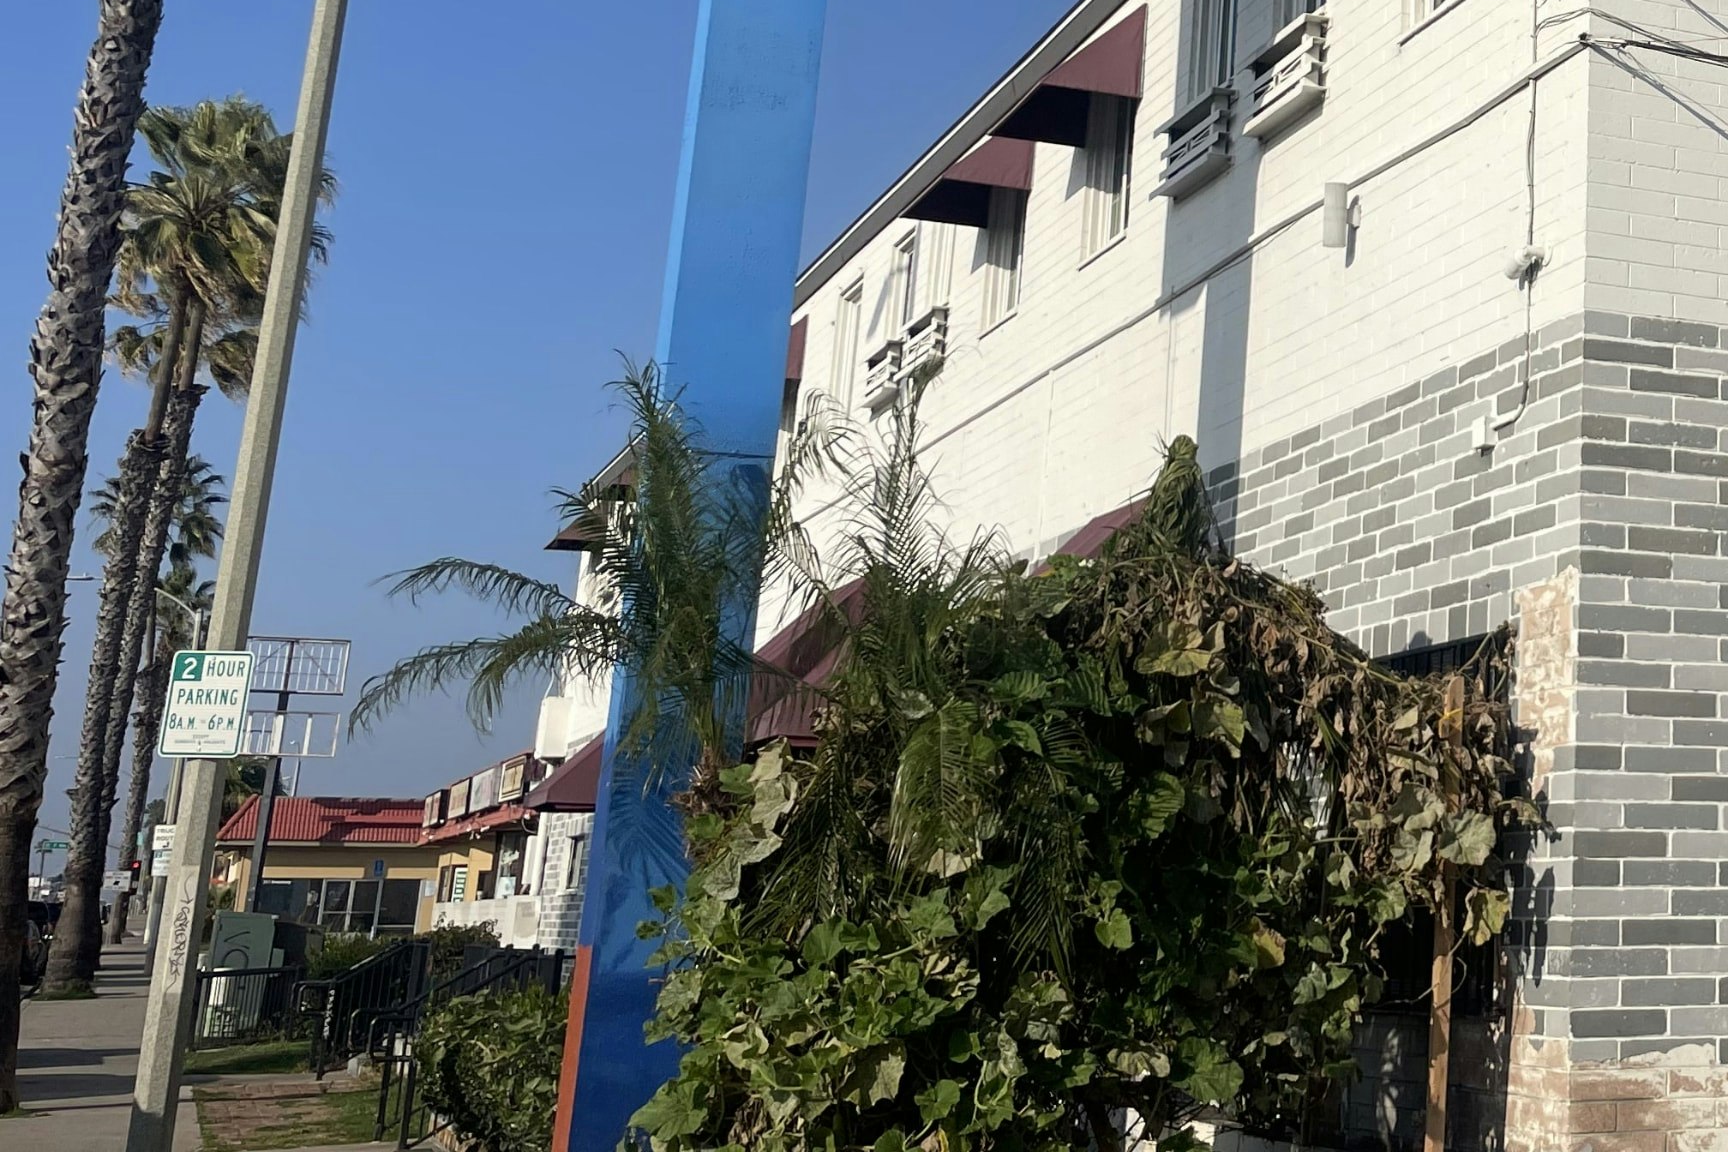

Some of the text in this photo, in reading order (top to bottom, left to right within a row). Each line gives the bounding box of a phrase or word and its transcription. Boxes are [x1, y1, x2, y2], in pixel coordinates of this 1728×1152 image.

[181, 656, 246, 680] 2 HOUR
[176, 688, 239, 706] PARKING
